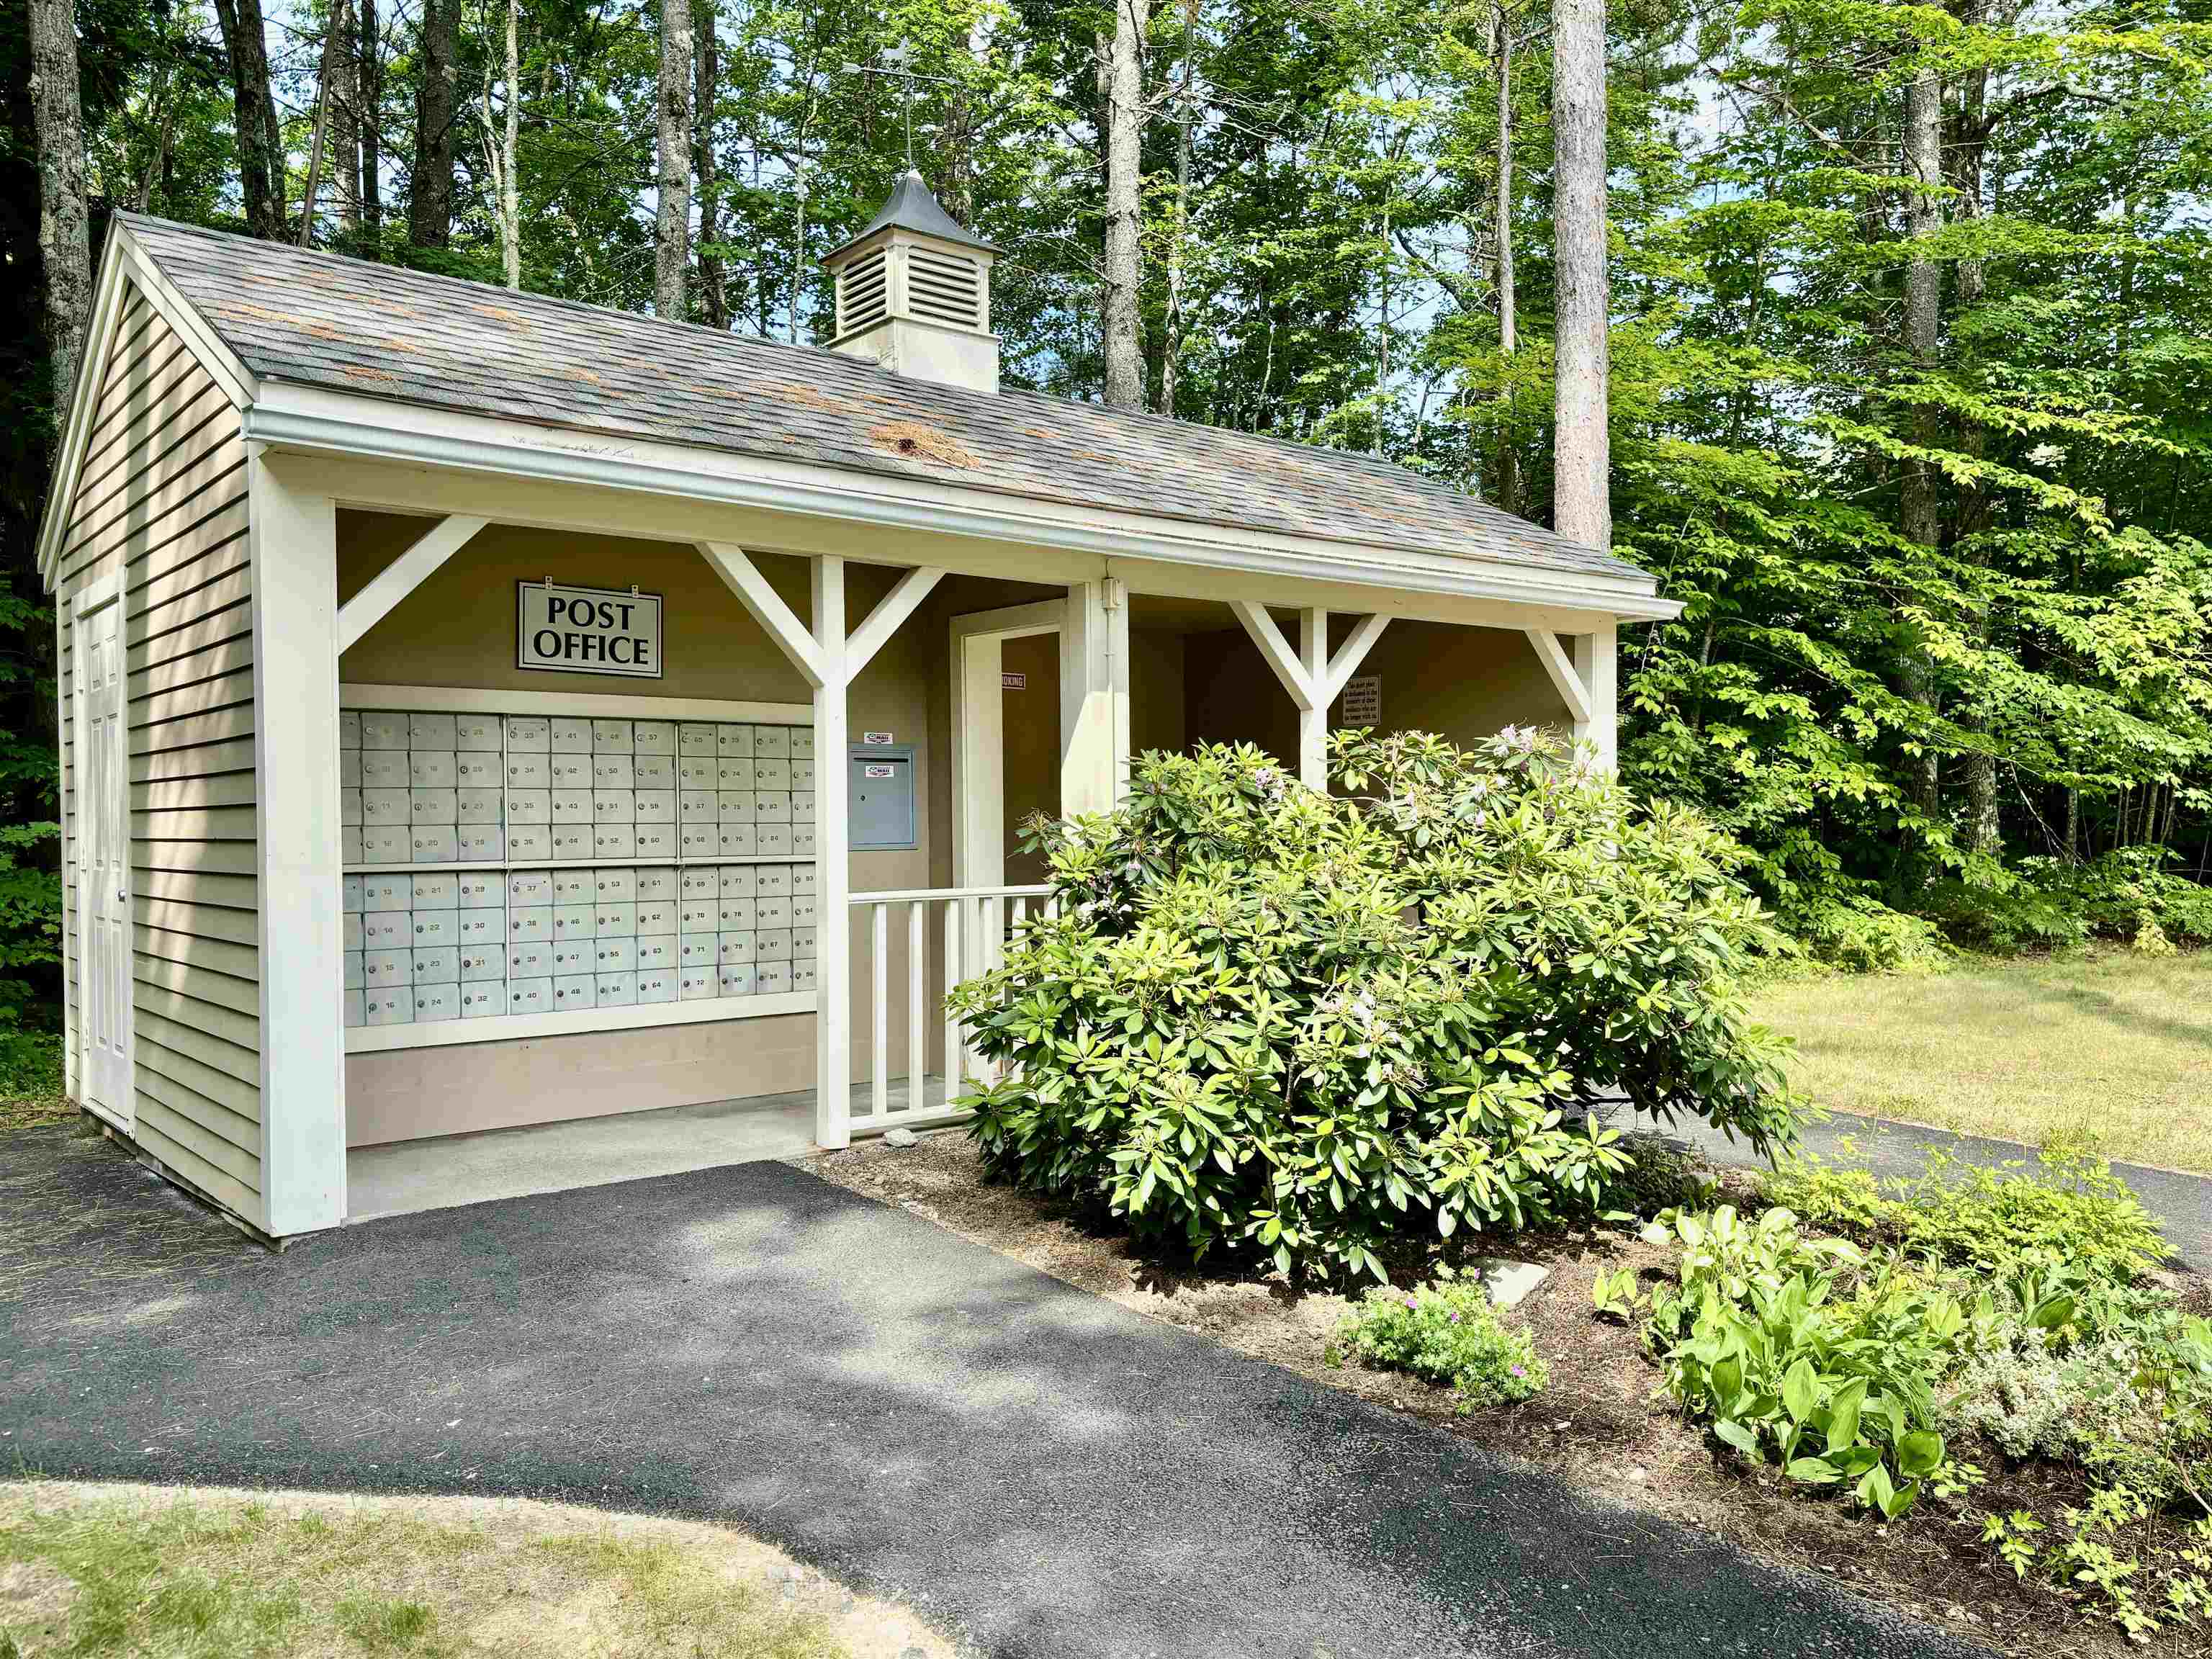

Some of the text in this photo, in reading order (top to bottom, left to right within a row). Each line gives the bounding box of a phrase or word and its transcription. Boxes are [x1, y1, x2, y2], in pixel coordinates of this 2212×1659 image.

[548, 597, 635, 630] POST
[534, 629, 649, 665] OFFICE
[1002, 675, 1023, 687] OKING
